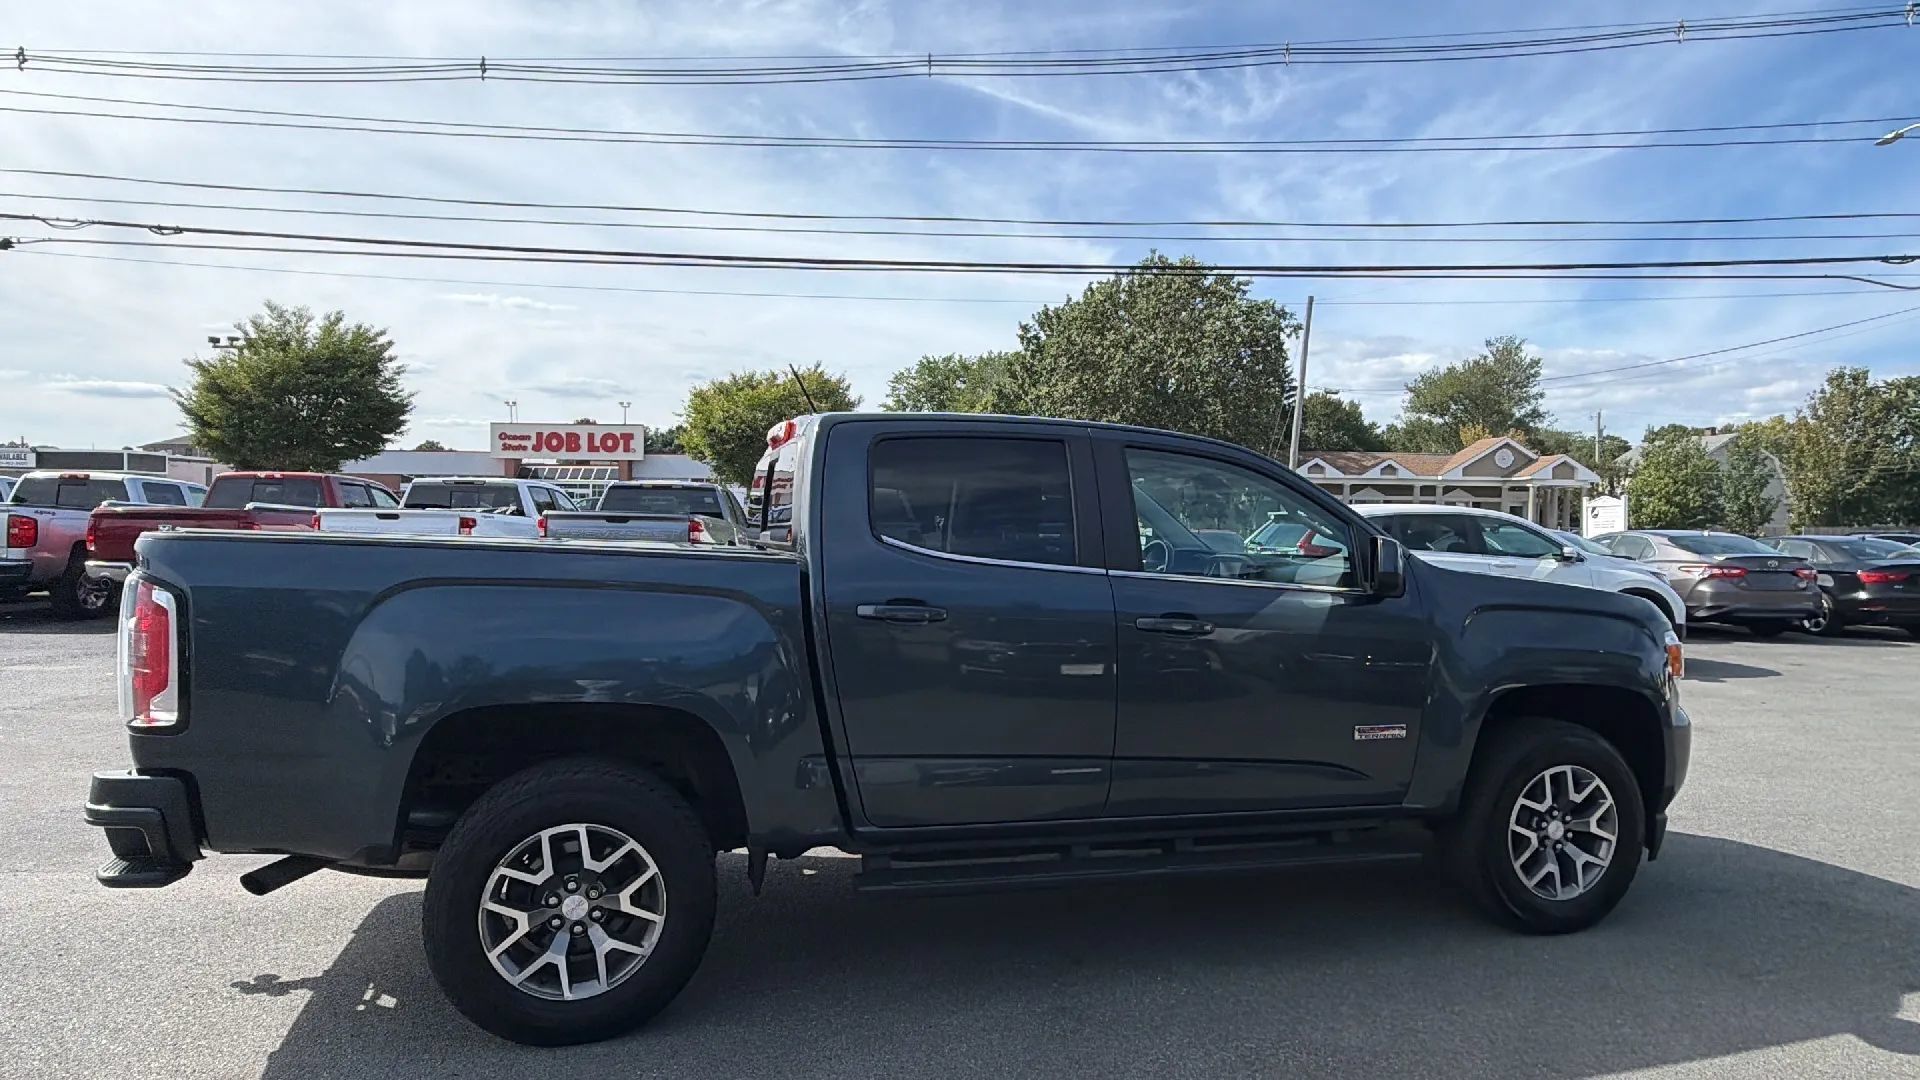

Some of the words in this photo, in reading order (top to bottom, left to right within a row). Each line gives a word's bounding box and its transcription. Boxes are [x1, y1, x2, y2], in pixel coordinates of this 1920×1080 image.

[498, 432, 532, 441] Ocean
[501, 442, 528, 451] State
[531, 431, 582, 453] JOB
[587, 432, 634, 453] LOT
